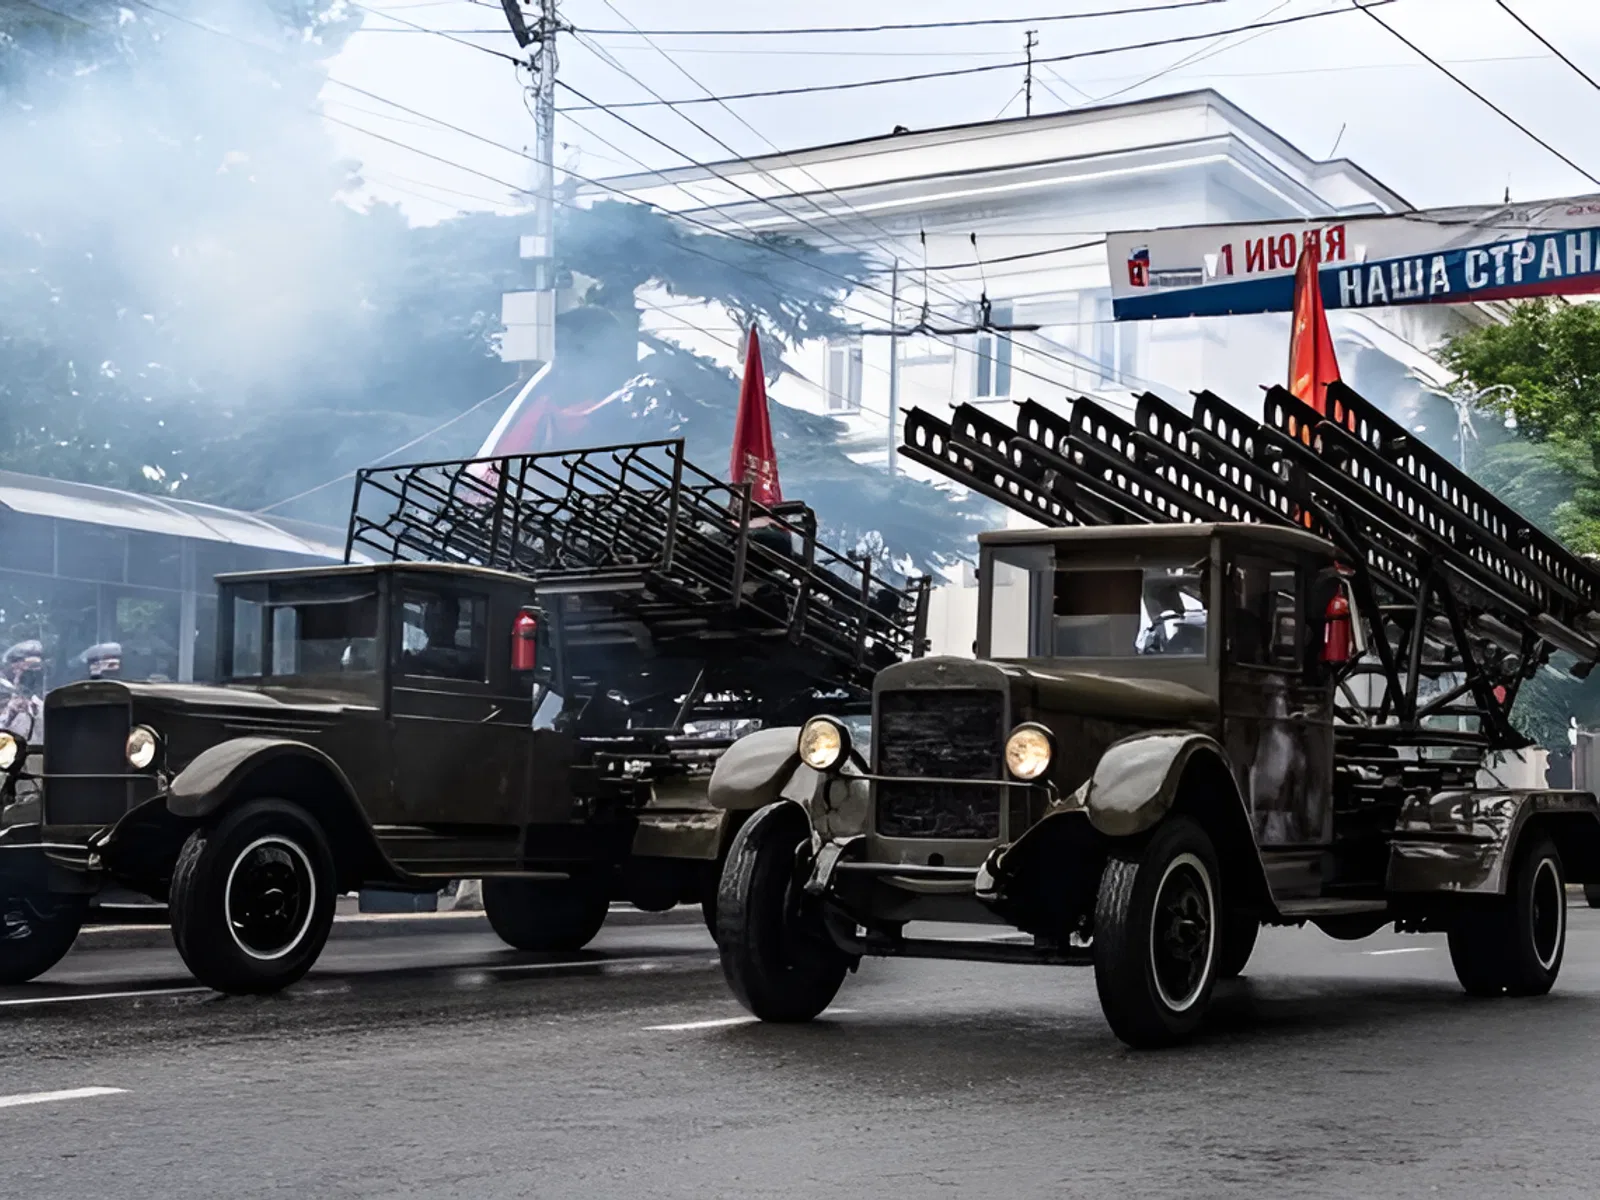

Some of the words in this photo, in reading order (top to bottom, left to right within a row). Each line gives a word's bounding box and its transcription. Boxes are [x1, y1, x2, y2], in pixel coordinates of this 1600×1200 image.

[1221, 243, 1234, 276] 1
[1338, 255, 1451, 307] НАША
[1465, 231, 1600, 289] СТРАН
